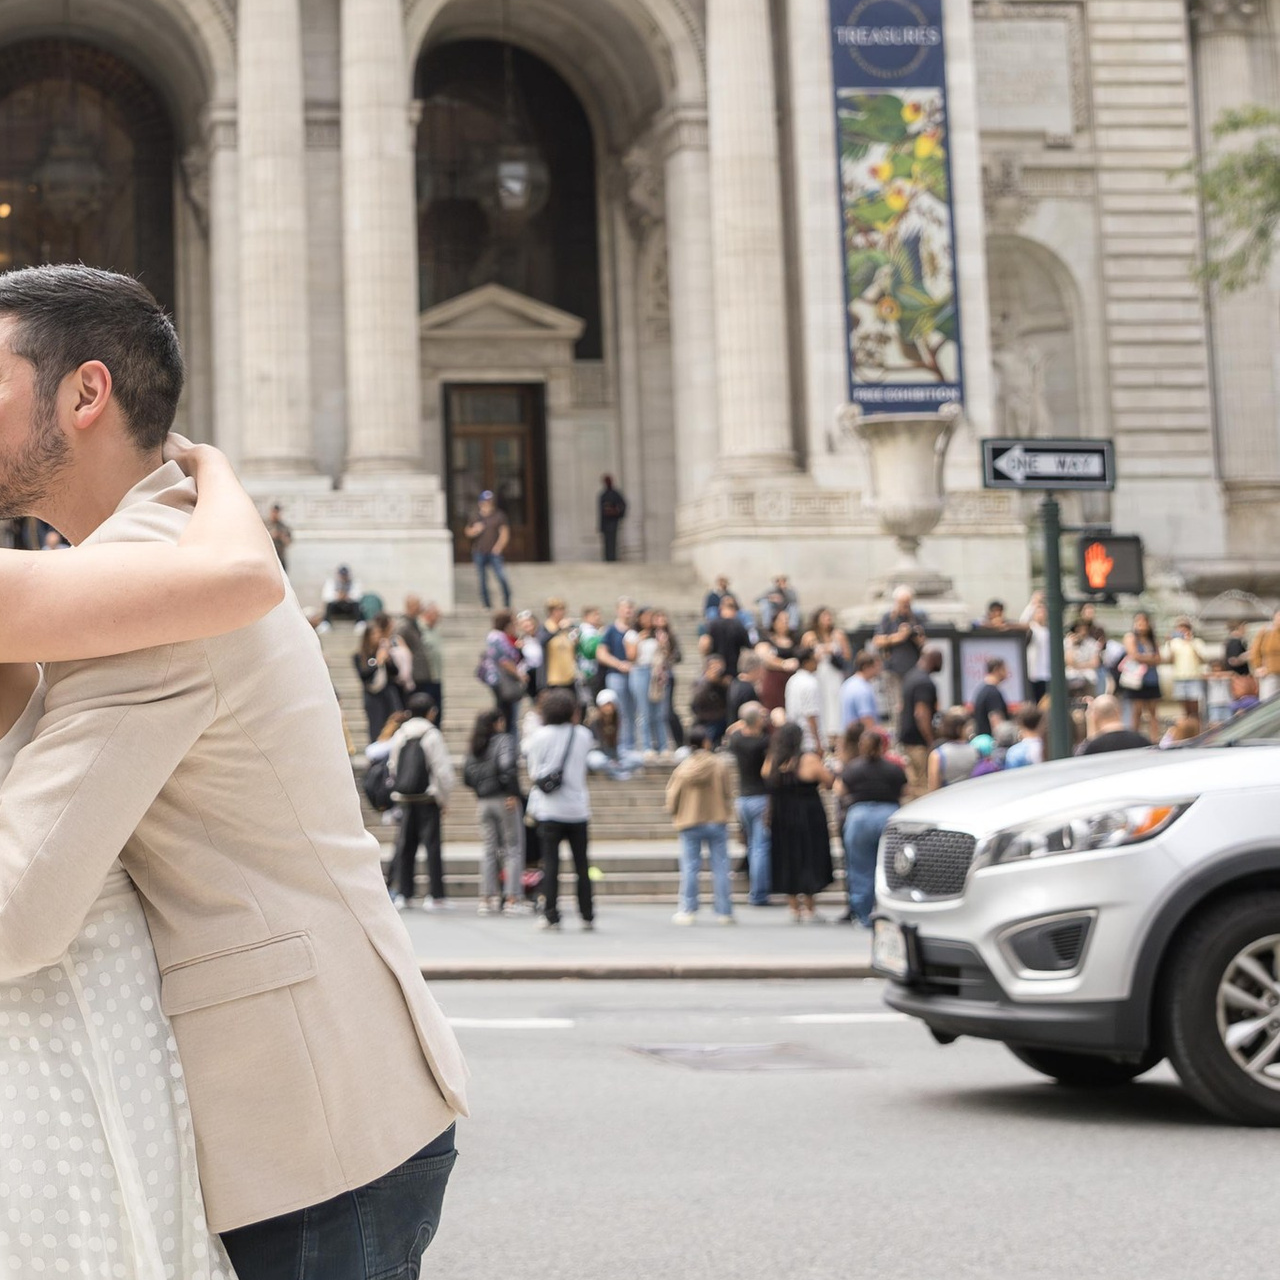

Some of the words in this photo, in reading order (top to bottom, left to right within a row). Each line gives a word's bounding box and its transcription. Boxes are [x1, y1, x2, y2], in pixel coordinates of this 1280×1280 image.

[833, 25, 941, 46] TREASURES
[1006, 454, 1039, 473] ONE
[1053, 454, 1094, 473] WAY
